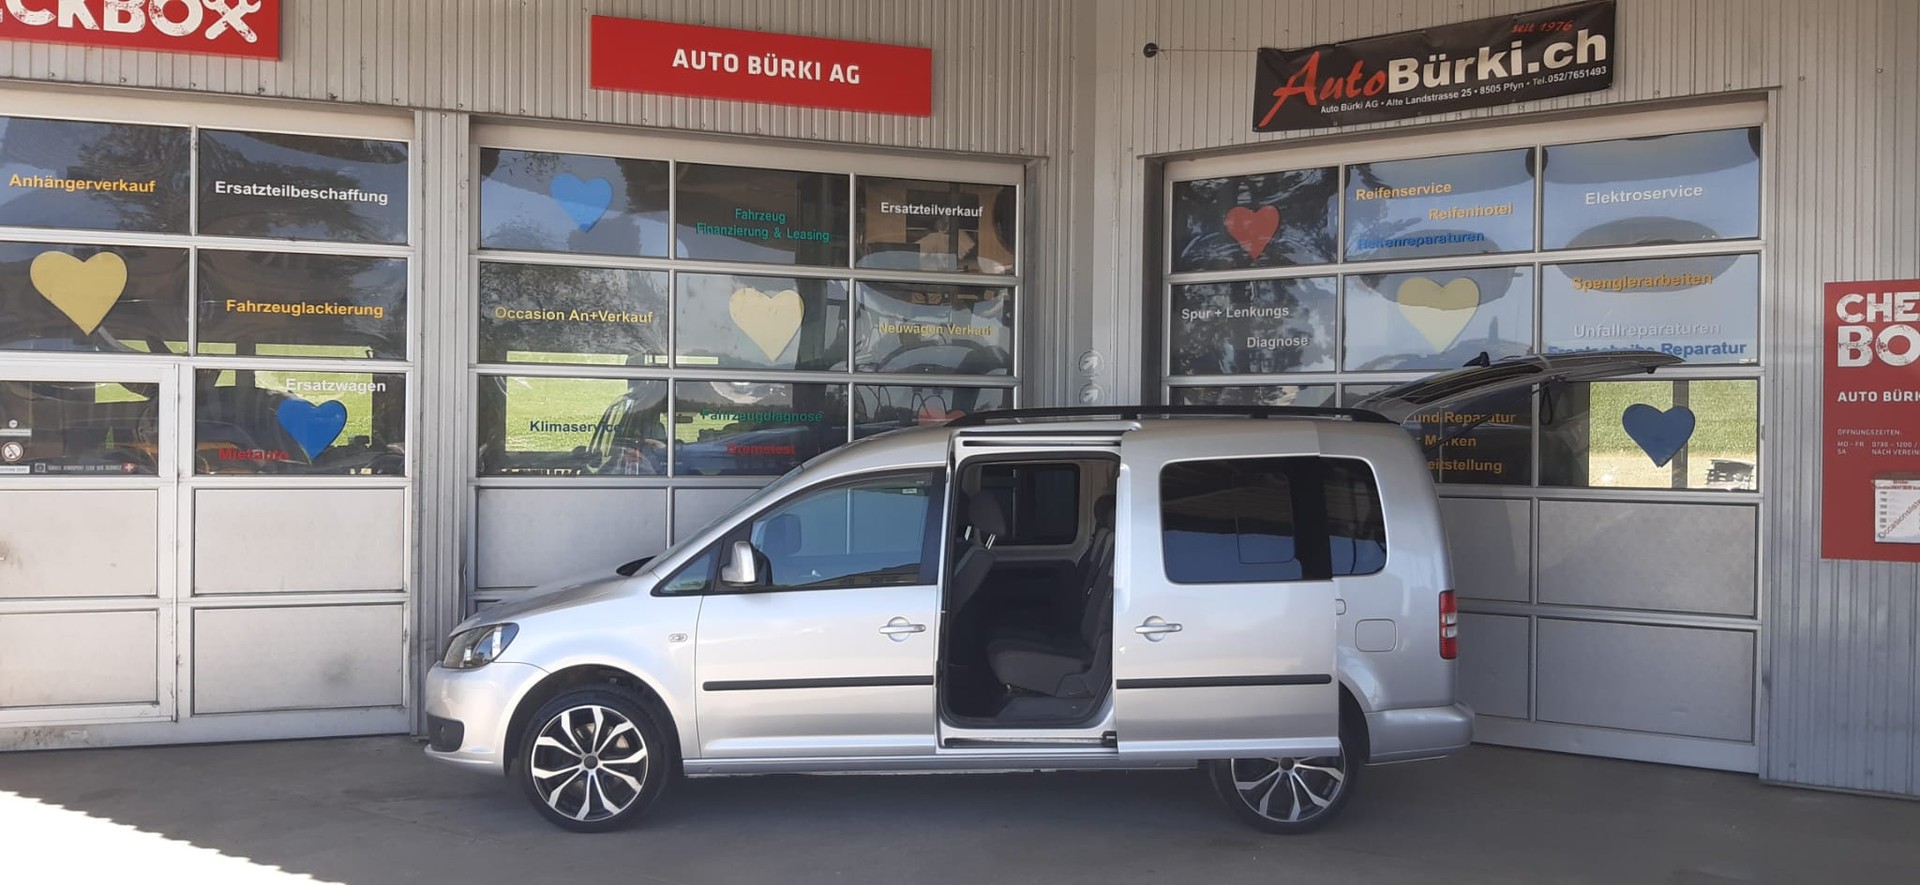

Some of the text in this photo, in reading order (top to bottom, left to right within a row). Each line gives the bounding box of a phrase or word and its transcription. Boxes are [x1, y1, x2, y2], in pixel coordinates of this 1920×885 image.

[0, 0, 262, 43] CKBOX
[1510, 20, 1574, 33] seit 1976
[672, 48, 860, 84] AUTO BÜRKI AG
[1320, 105, 1339, 114] Auto
[1341, 102, 1363, 112] Bürki
[1365, 100, 1379, 108] AG
[1385, 98, 1403, 107] Alte
[1405, 92, 1459, 105] Landstrasse
[1461, 89, 1472, 97] 25
[1480, 85, 1501, 95] 8505
[1503, 81, 1524, 92] Pfyn
[9, 173, 157, 193] Anhängerverkauf
[1356, 182, 1452, 201] Reifenservice
[215, 181, 388, 206] Ersatzteilbeschaffung
[1585, 184, 1704, 206] Elektroservice
[735, 208, 786, 225] Fahrzeug
[881, 202, 983, 218] Ersatzteilverkauf
[1429, 202, 1514, 221] Reifenhotel
[696, 222, 830, 243] Finanzierung & Leasing
[1572, 272, 1713, 292] Spenglerarbeiten
[226, 299, 385, 319] Fahrzeuglackierung
[495, 306, 654, 324] Occasion An+Verkauf
[1181, 305, 1289, 322] Spur + Lenkungs
[878, 322, 993, 337] Neuwagen Verkauf
[1574, 321, 1722, 340] Unfallreparaturen
[1247, 336, 1309, 350] Diagnose
[1661, 341, 1747, 358] Reparatur
[286, 377, 387, 394] Ersatzwagen
[1837, 391, 1878, 402] AUTO
[702, 409, 823, 424] Fahrzeugdiagnose
[1413, 411, 1516, 425] und Repatur
[530, 420, 621, 433] Klimaservice
[1425, 434, 1477, 447] Mken
[1427, 459, 1503, 473] eitstellung
